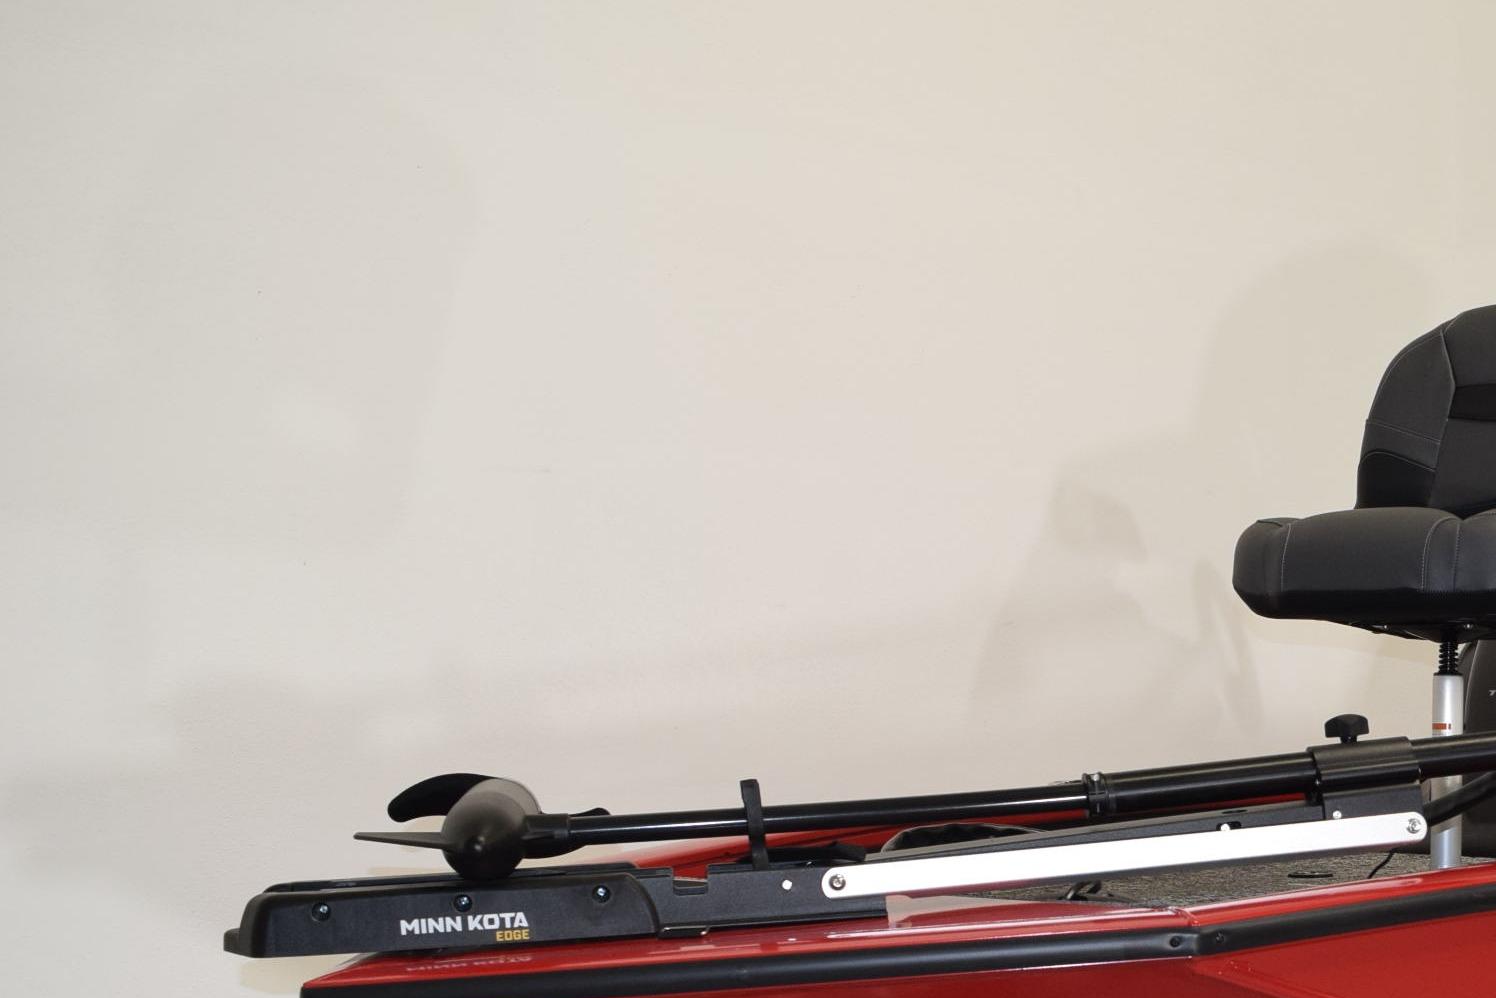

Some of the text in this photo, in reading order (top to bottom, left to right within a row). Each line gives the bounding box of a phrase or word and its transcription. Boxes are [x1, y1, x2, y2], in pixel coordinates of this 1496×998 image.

[400, 911, 529, 936] MINN KOTA
[496, 930, 530, 942] EDGE
